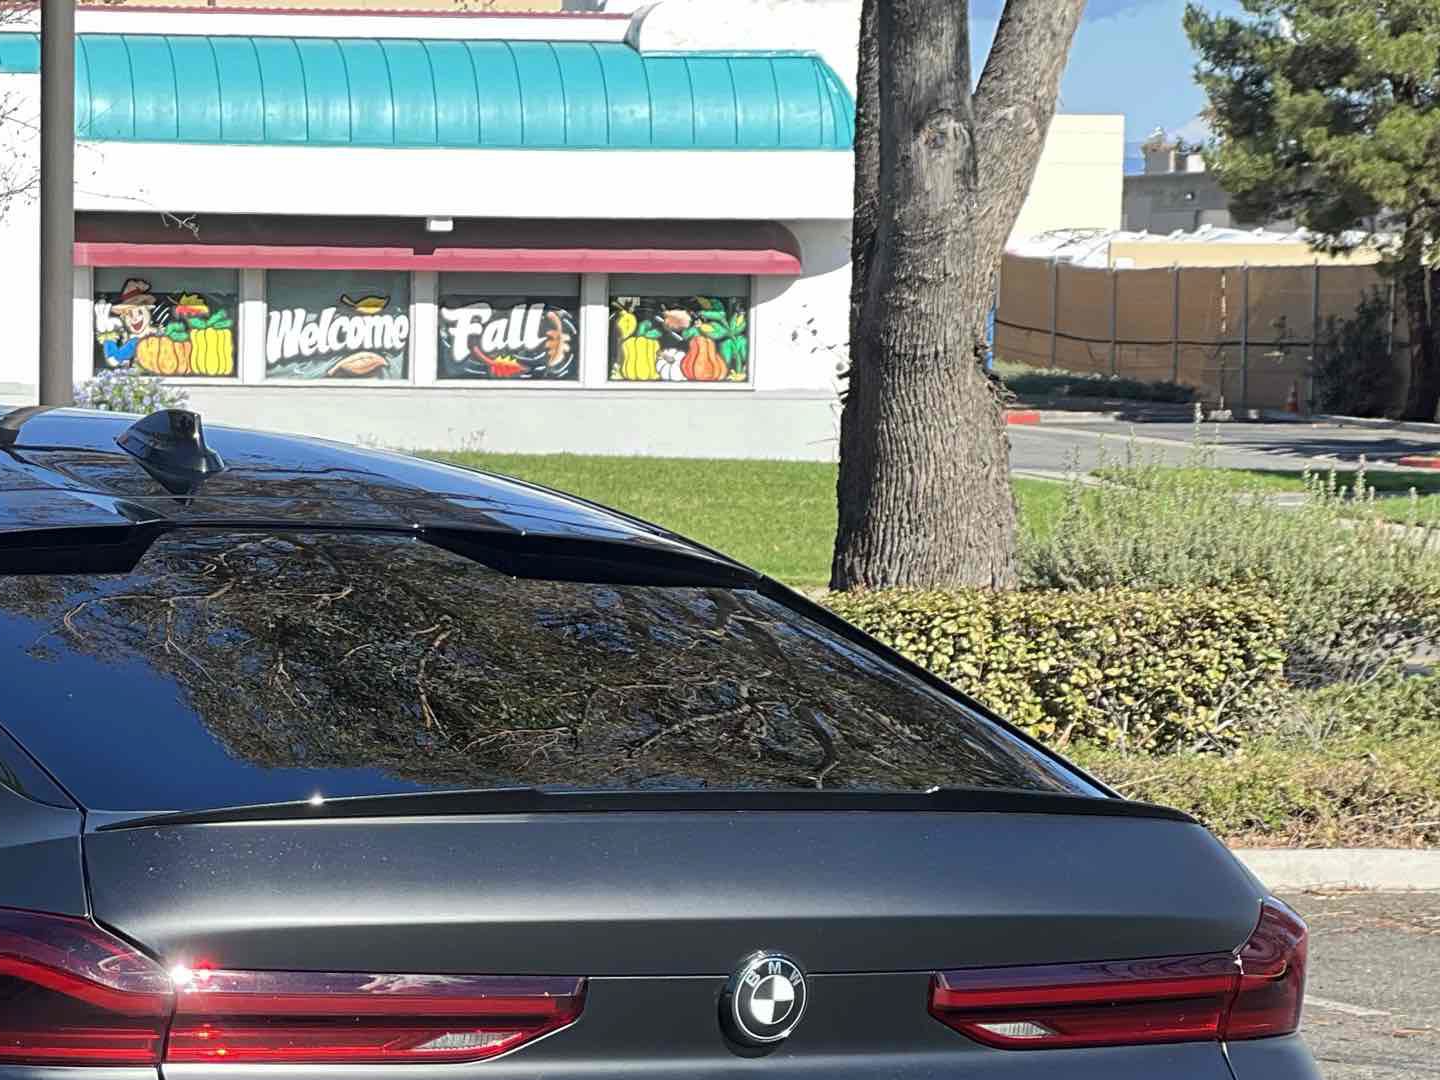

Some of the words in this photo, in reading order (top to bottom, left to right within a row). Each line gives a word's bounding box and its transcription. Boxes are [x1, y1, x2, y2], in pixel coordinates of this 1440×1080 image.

[266, 307, 409, 364] Welcome
[440, 303, 549, 362] Fall
[744, 961, 801, 987] BMW
